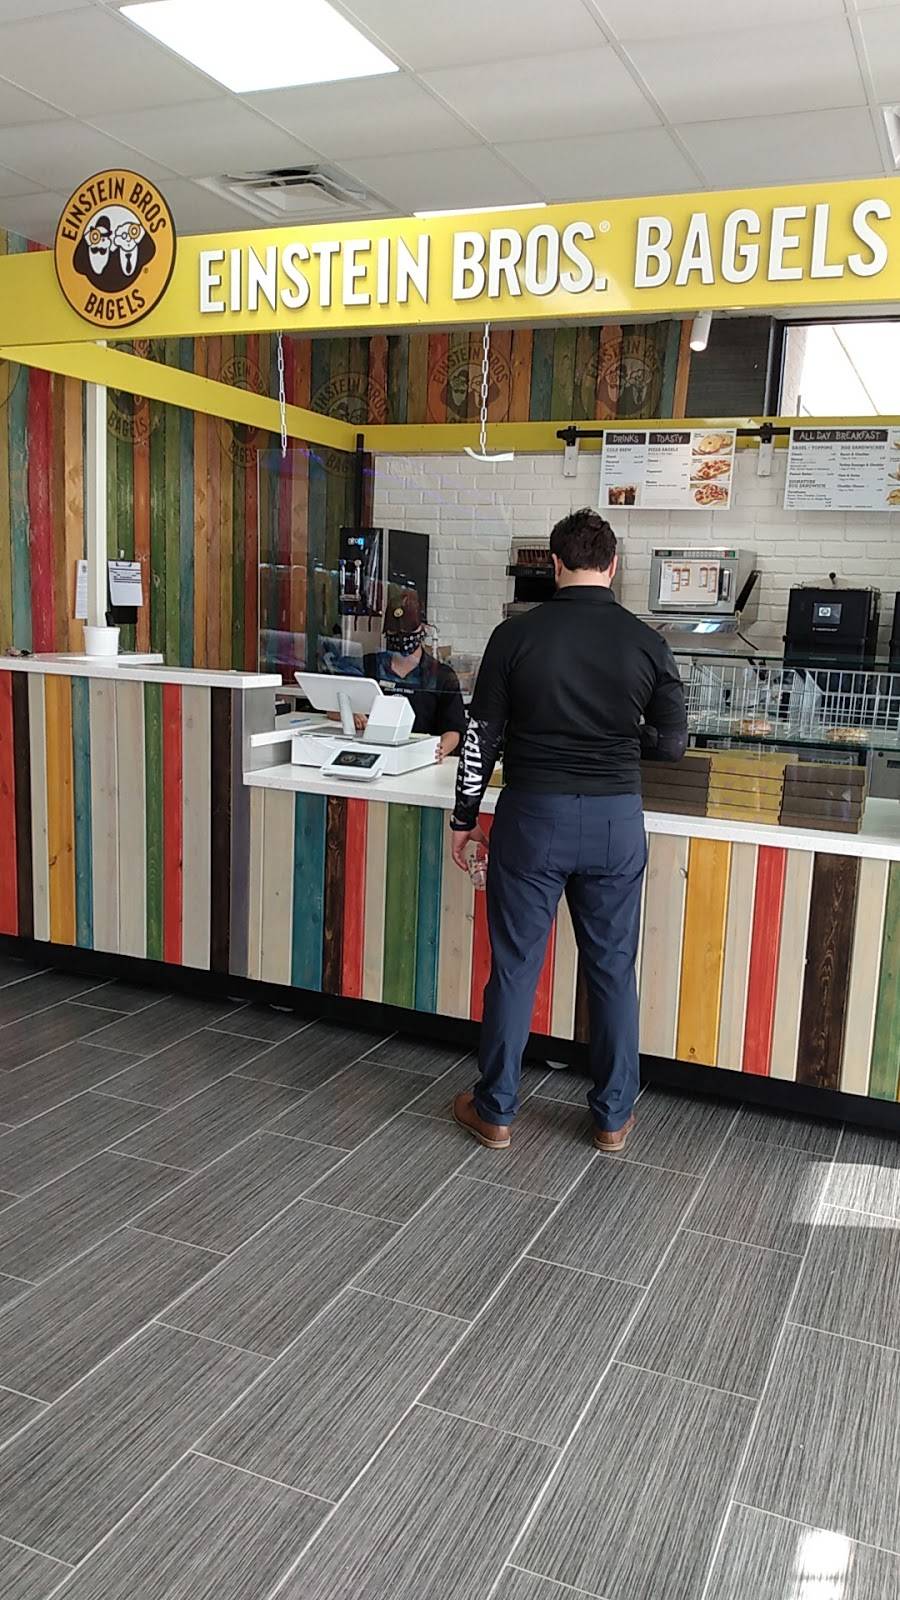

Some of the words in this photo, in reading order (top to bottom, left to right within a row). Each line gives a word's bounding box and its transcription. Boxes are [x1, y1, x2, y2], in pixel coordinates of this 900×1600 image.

[61, 177, 125, 241] EINSTEIN
[129, 182, 167, 234] BROS
[200, 234, 430, 313] EINSTEIN
[452, 221, 608, 300] BROS.
[634, 199, 892, 289] BAGELS
[84, 288, 146, 321] BAGELS
[107, 409, 148, 438] BAGELS
[613, 433, 639, 443] DRINKS
[656, 433, 683, 443] TOASTY
[799, 431, 815, 441] ALL
[816, 431, 831, 441] DAY
[836, 430, 880, 441] BREAKFAST
[462, 709, 482, 796] AGELLAN
